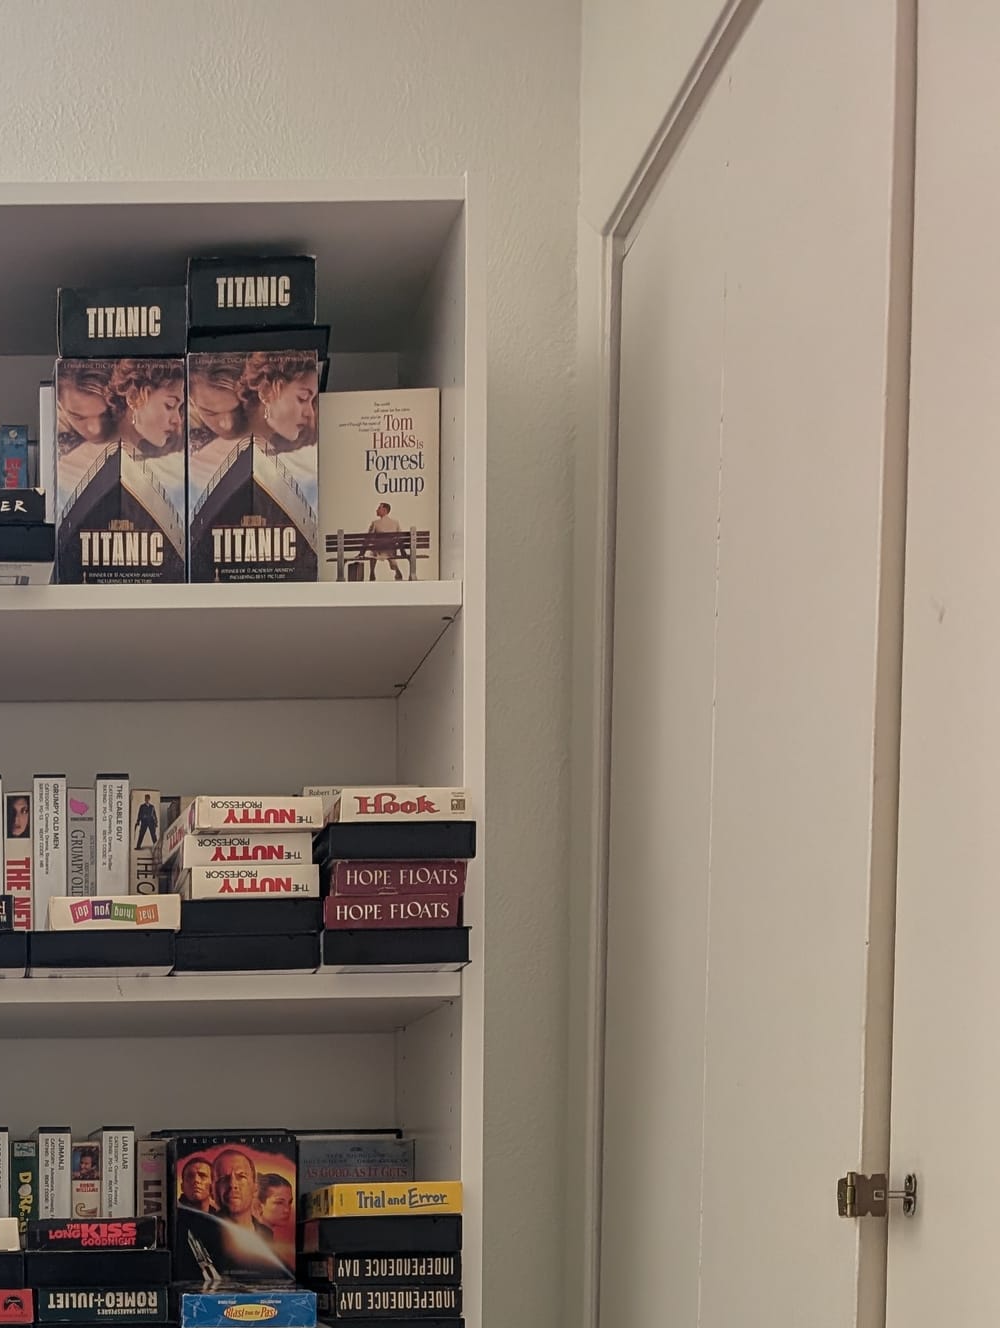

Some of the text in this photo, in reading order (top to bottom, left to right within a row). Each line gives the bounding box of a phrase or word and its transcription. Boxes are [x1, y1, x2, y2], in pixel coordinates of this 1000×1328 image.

[216, 276, 291, 308] TITANIC
[86, 306, 161, 338] TITANIC
[384, 414, 413, 432] Tom
[372, 432, 416, 449] Hanks
[365, 449, 425, 472] Forrest
[374, 471, 425, 497] Gump
[80, 531, 164, 567] TITANIC
[211, 527, 297, 563] TITANIC
[210, 800, 263, 809] PROFESSOR
[354, 792, 440, 815] Hook
[223, 808, 314, 824] THE NUTTY
[197, 837, 250, 847] PROFESSOR
[70, 829, 86, 876] GRUMPY
[210, 845, 302, 862] THE NUTTY
[136, 857, 154, 880] THE
[205, 870, 258, 879] PROFESSOR
[346, 867, 458, 886] HOPE FLOATS
[7, 857, 31, 930] THE NET
[218, 877, 310, 893] THE NUTTY
[336, 901, 450, 921] HOPE FLOATS
[182, 1136, 293, 1145] BRUCE WILLIS
[320, 1168, 351, 1178] GOOD
[381, 1167, 408, 1177] GETS
[356, 1187, 448, 1209] Trial and Error
[48, 1222, 137, 1239] THE LONG KISS
[81, 1237, 137, 1247] GOODNIGHT
[338, 1258, 454, 1278] INDEPENDENCE DAY
[48, 1291, 158, 1309] ROMEO+JULIET
[340, 1290, 455, 1310] INDEPENDENCE DAY
